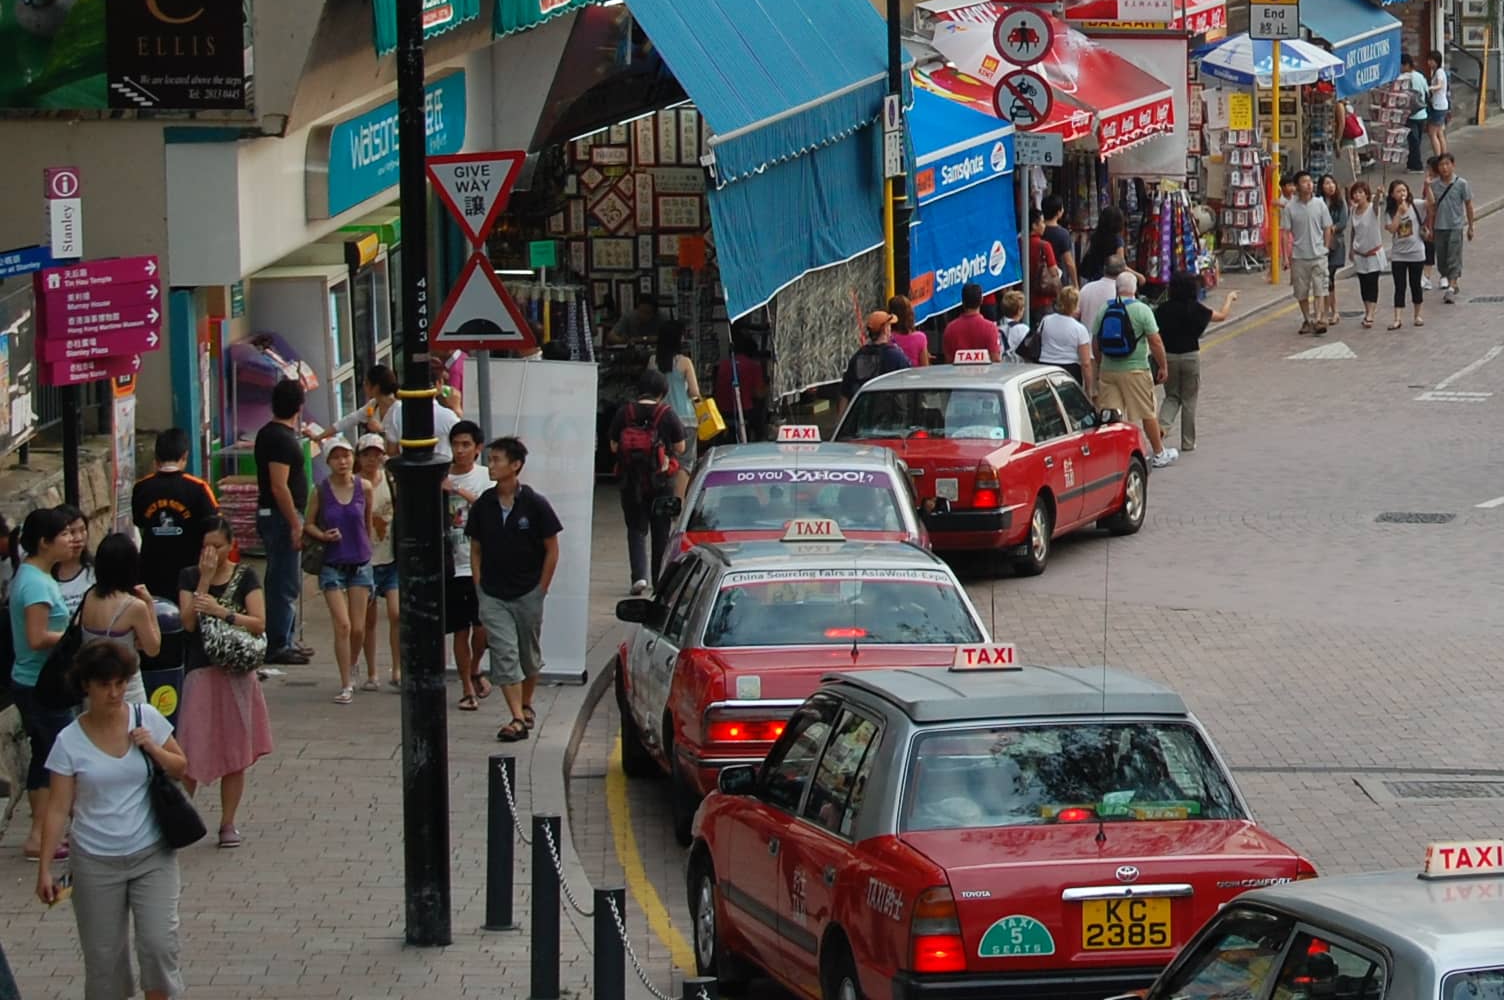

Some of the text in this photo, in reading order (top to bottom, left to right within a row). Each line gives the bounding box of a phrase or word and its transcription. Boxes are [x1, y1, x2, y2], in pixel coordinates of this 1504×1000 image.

[1263, 8, 1285, 20] End
[1260, 23, 1289, 35] 終止
[137, 34, 217, 56] ELLIS
[1356, 38, 1391, 65] COLLECTORS
[1356, 63, 1380, 87] GALLERY
[454, 164, 491, 178] GIVE
[941, 153, 985, 187] Samsonite
[455, 179, 491, 193] WAY
[465, 195, 486, 217] 讓
[62, 204, 74, 253] Stanley
[937, 251, 988, 293] Samsonite
[417, 277, 428, 342] 43403
[66, 349, 90, 358] Stanley
[957, 351, 985, 362] TAXI
[783, 427, 817, 439] TAXI
[737, 471, 755, 481] DO
[758, 471, 783, 480] YOU
[795, 521, 832, 535] TAXI
[732, 572, 764, 582] China
[766, 570, 816, 579] Sourcing
[962, 647, 1014, 665] TAXI
[1439, 846, 1503, 870] TAXI
[961, 890, 992, 898] TOYOTA
[1000, 918, 1035, 930] TAXI
[1010, 927, 1023, 944] 5
[1087, 924, 1167, 947] 2385
[992, 944, 1042, 954] SEATS
